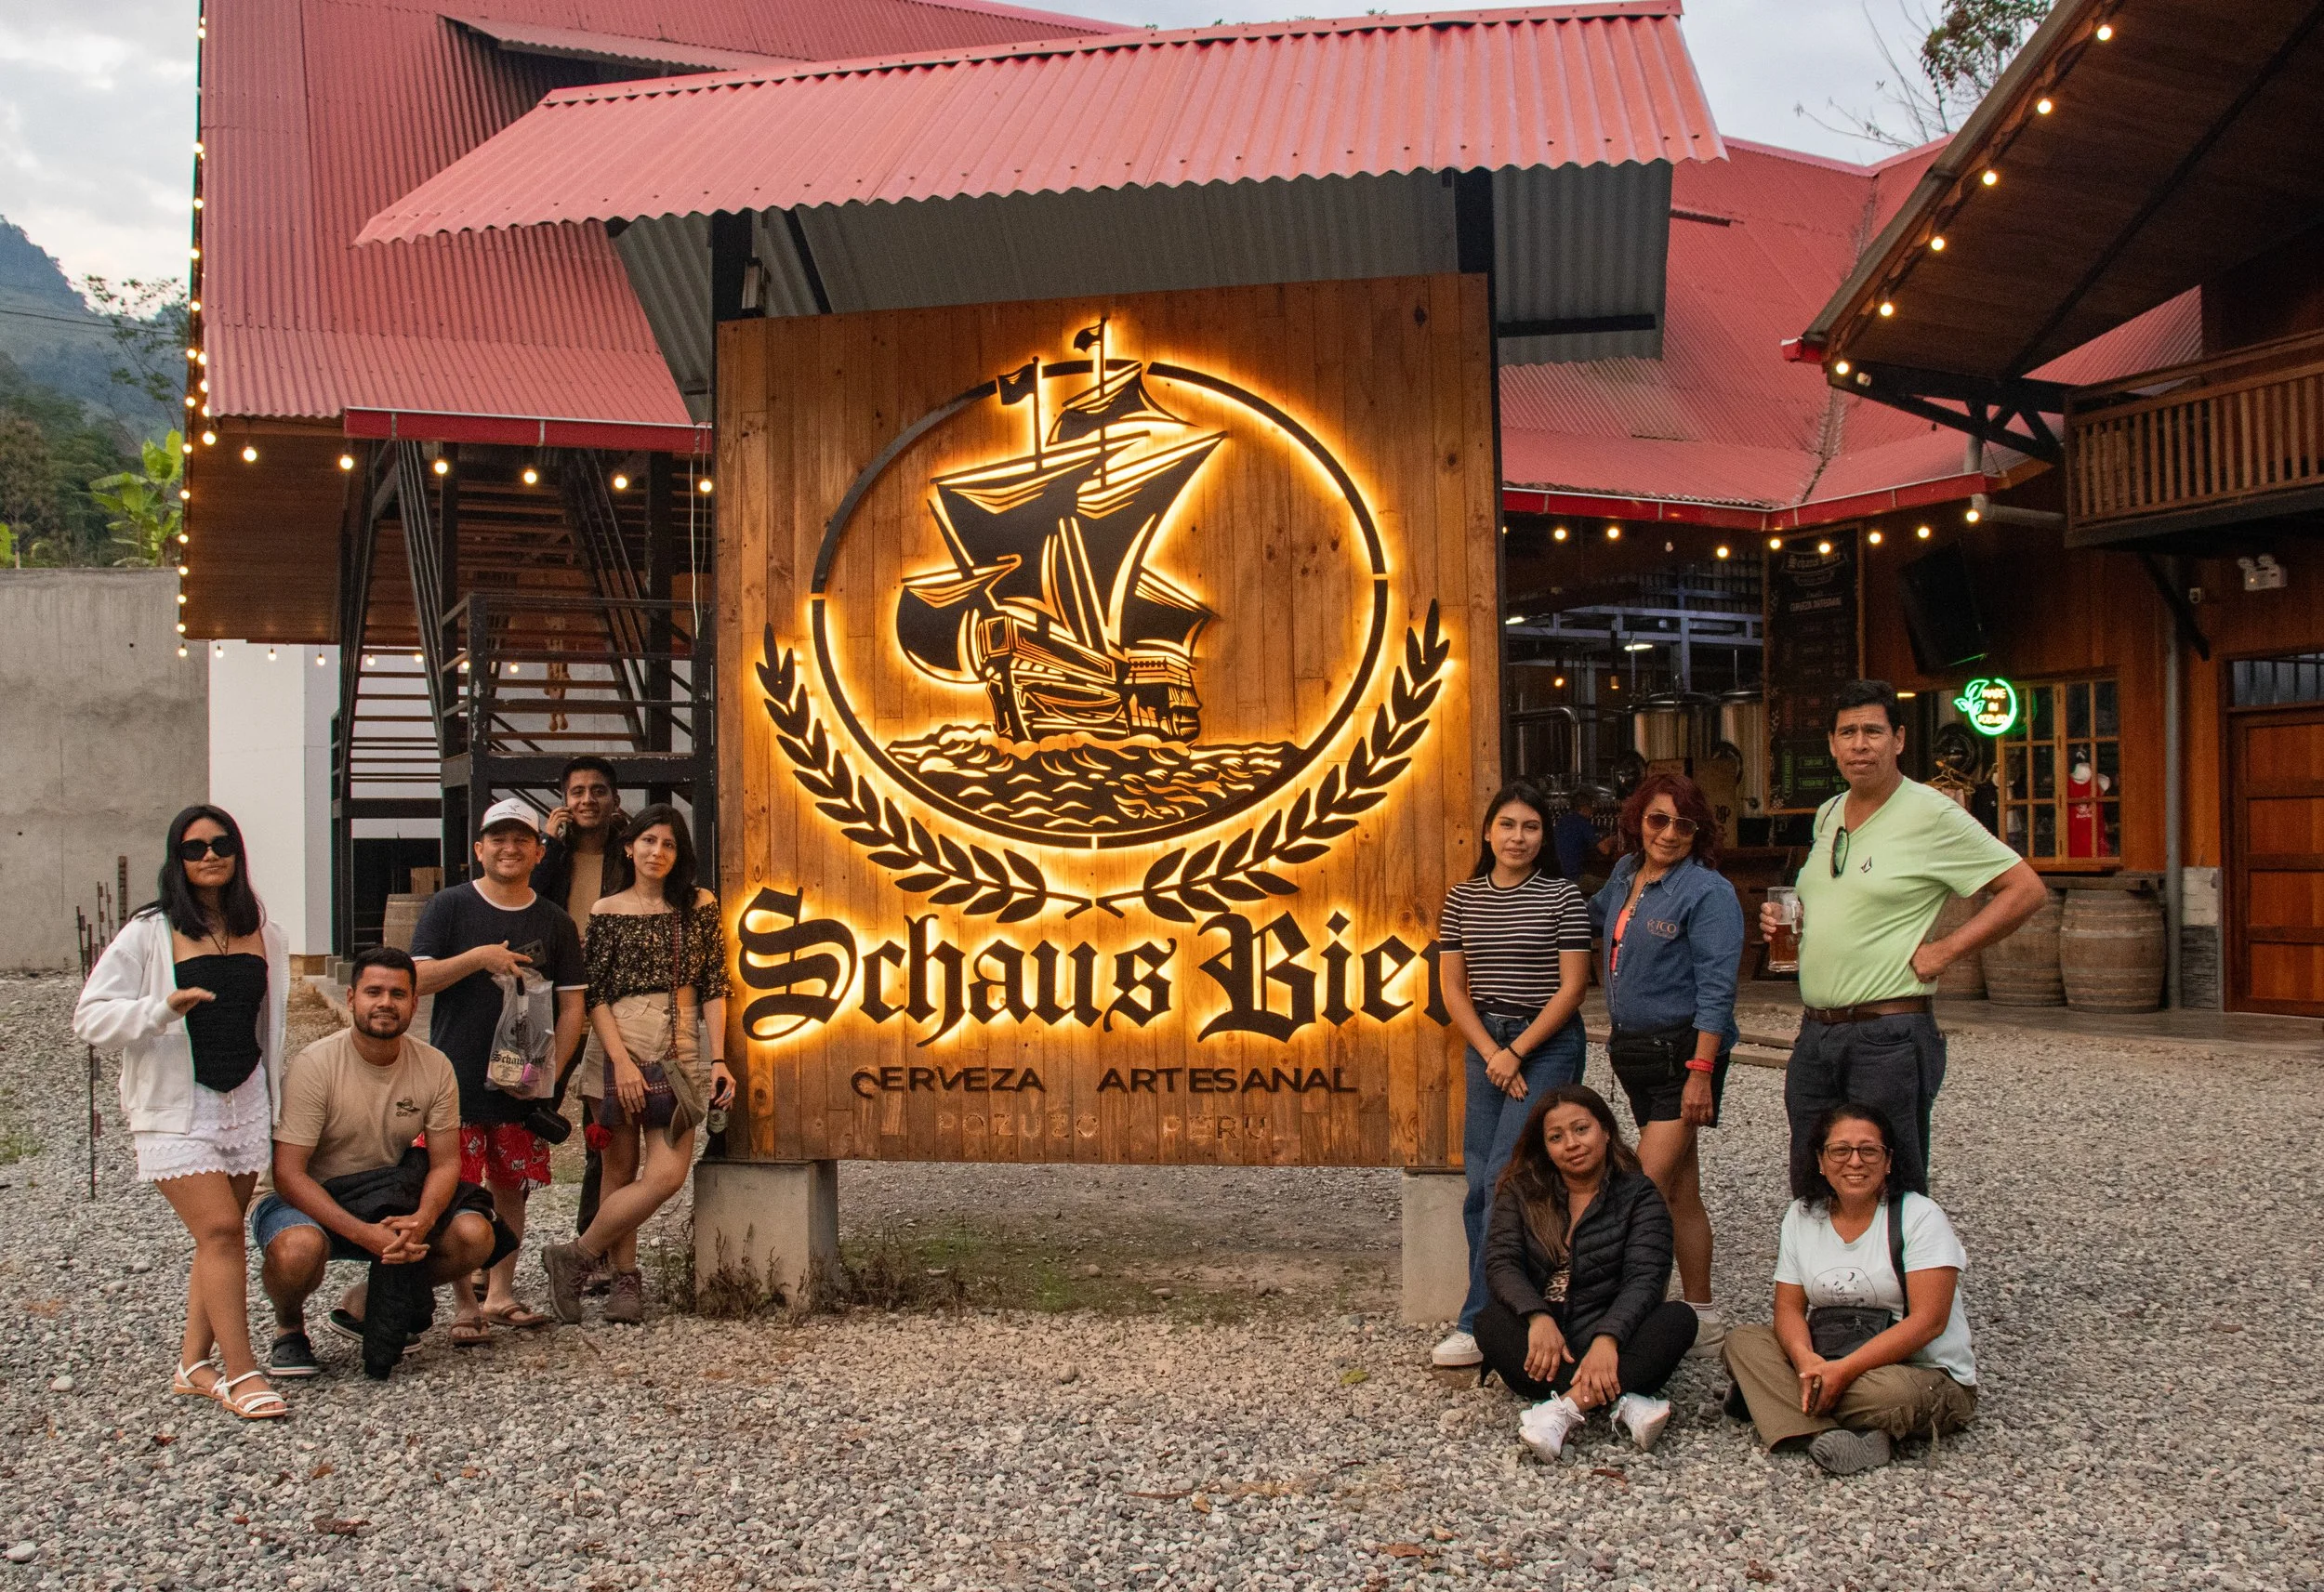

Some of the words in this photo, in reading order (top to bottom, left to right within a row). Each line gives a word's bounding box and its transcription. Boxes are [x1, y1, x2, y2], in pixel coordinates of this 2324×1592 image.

[738, 886, 1177, 1047] Schaus
[851, 1066, 1046, 1099] CERVEZA
[1097, 1067, 1357, 1094] ARTESANAL
[938, 1114, 1099, 1139] POZUZO
[1163, 1114, 1267, 1140] PERU
